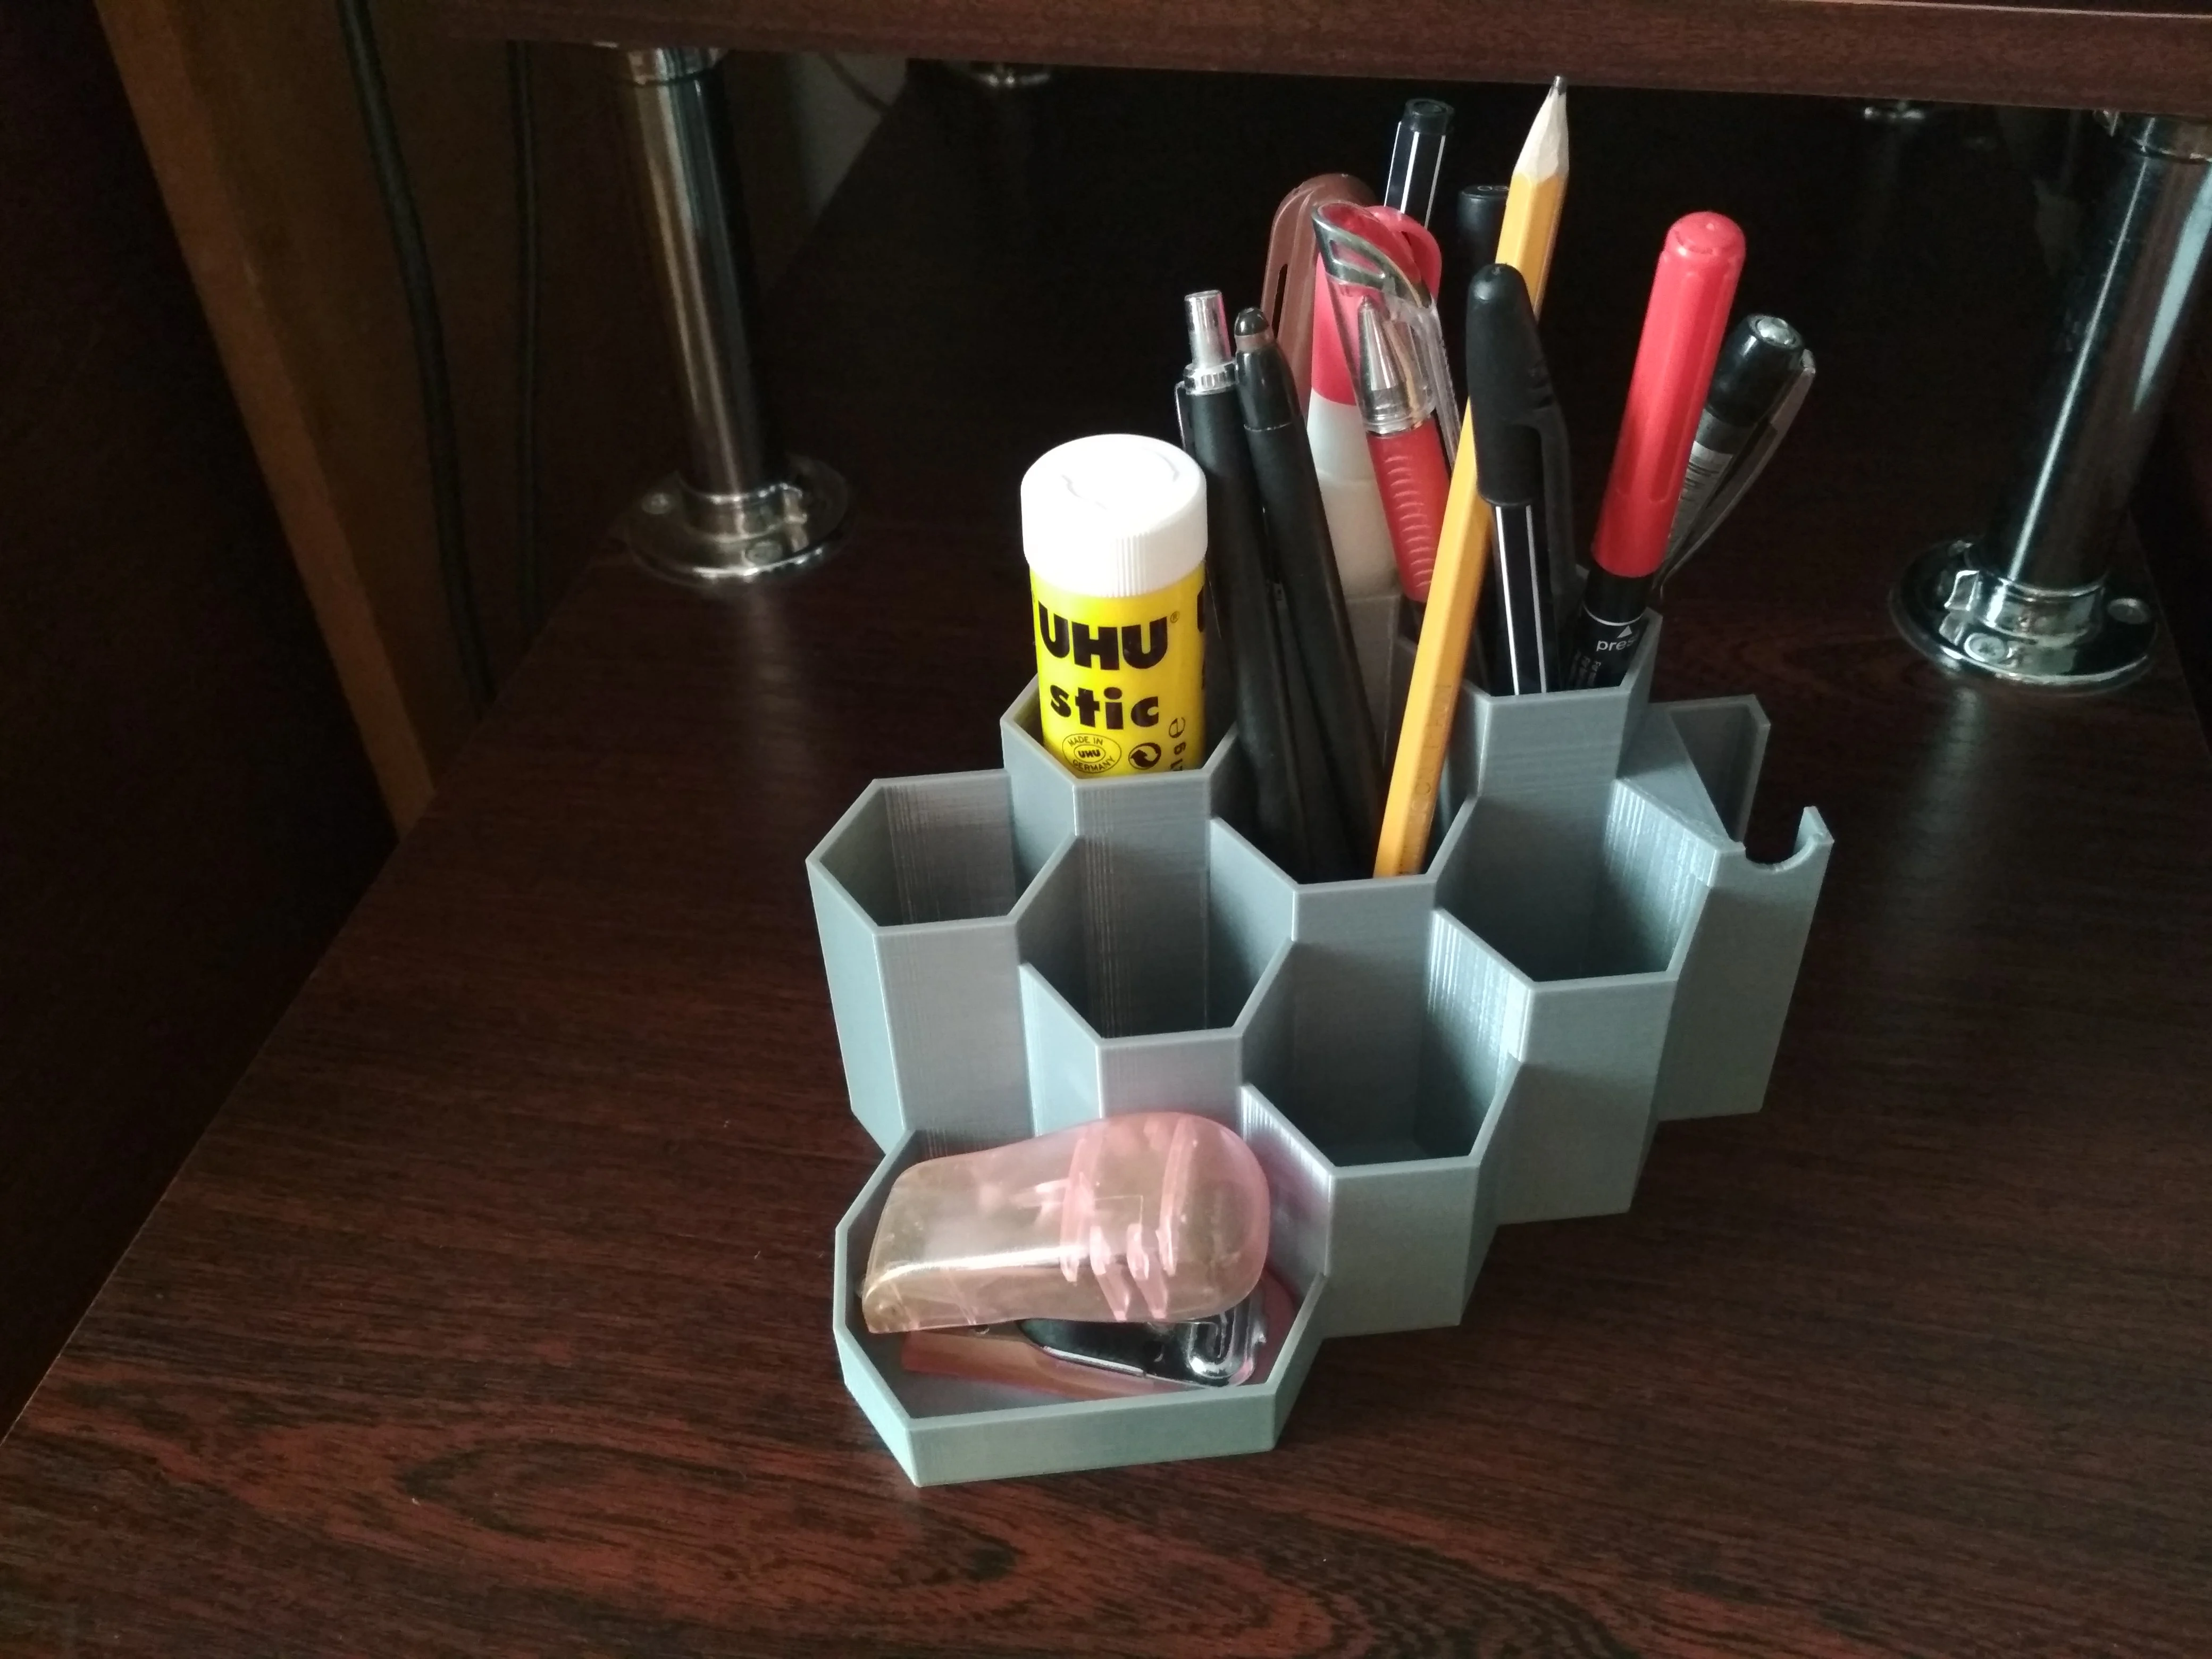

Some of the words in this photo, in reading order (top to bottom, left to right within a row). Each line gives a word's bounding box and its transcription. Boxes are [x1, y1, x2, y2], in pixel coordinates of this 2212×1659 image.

[1050, 685, 1159, 730] stic
[1068, 736, 1090, 747] MADE
[1093, 737, 1103, 746] IN
[1078, 749, 1101, 758] UHU
[1073, 756, 1115, 771] GERMANY
